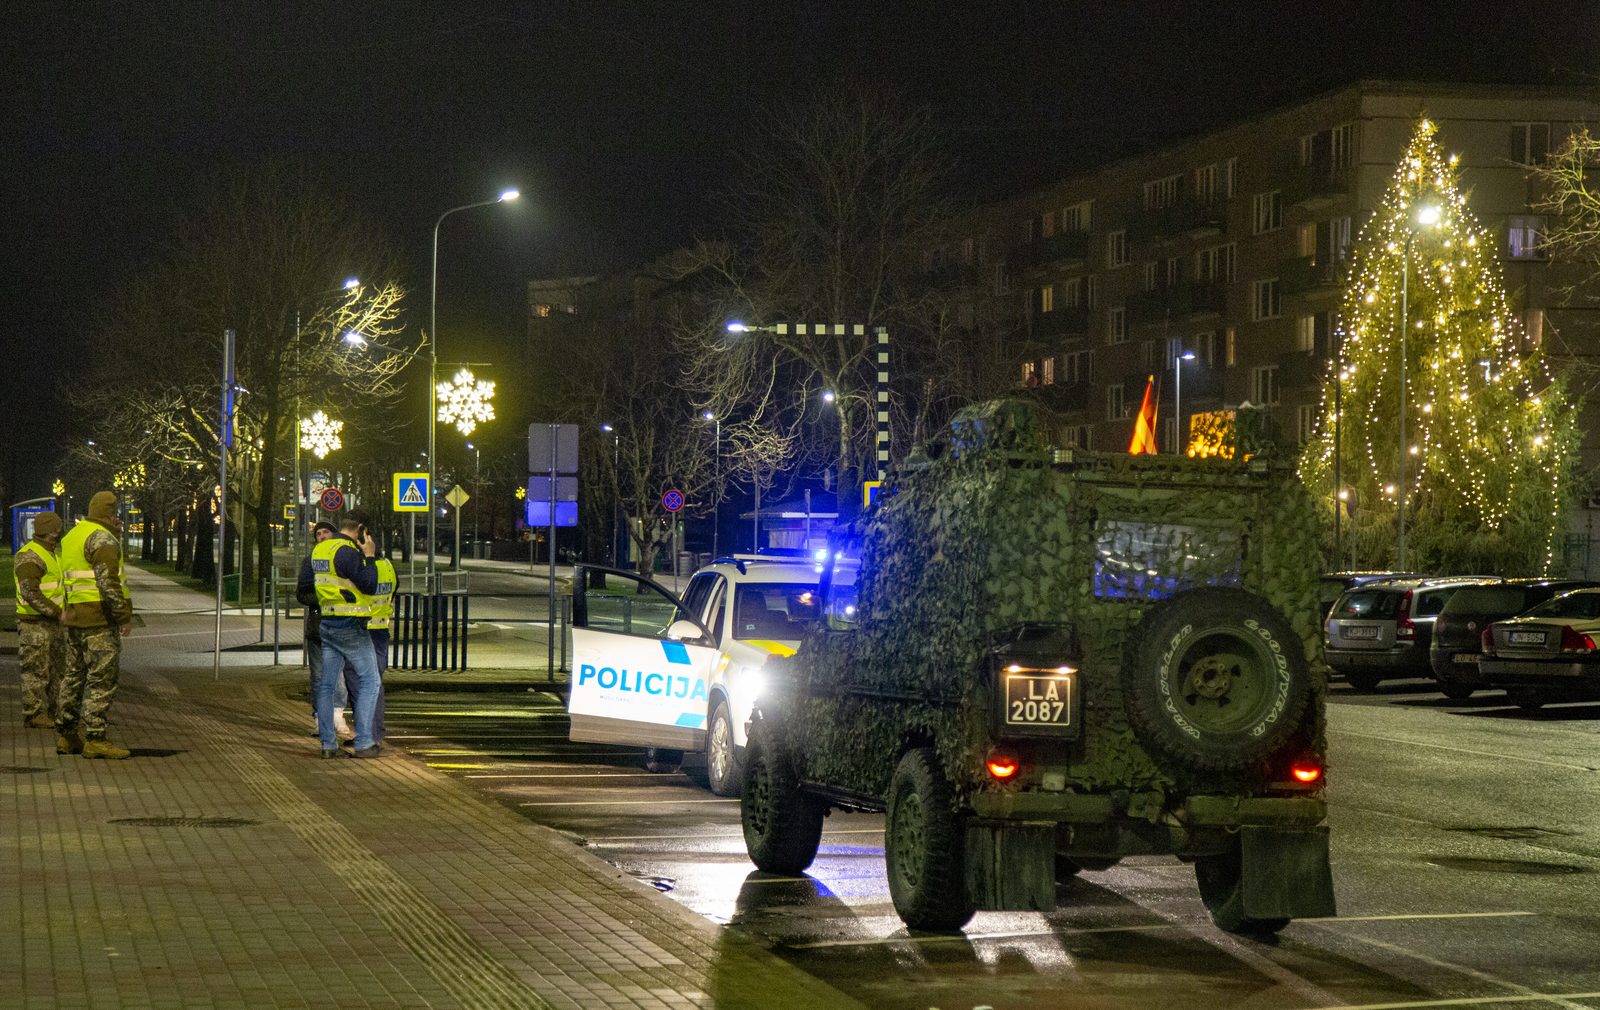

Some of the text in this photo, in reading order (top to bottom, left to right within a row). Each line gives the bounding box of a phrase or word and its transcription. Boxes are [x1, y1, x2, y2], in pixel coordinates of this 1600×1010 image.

[578, 664, 708, 702] POLICIJA
[1029, 679, 1060, 701] LA
[1160, 624, 1200, 740] WRANGLER
[1244, 619, 1290, 737] GOODYEAR
[1011, 700, 1065, 722] 2087
